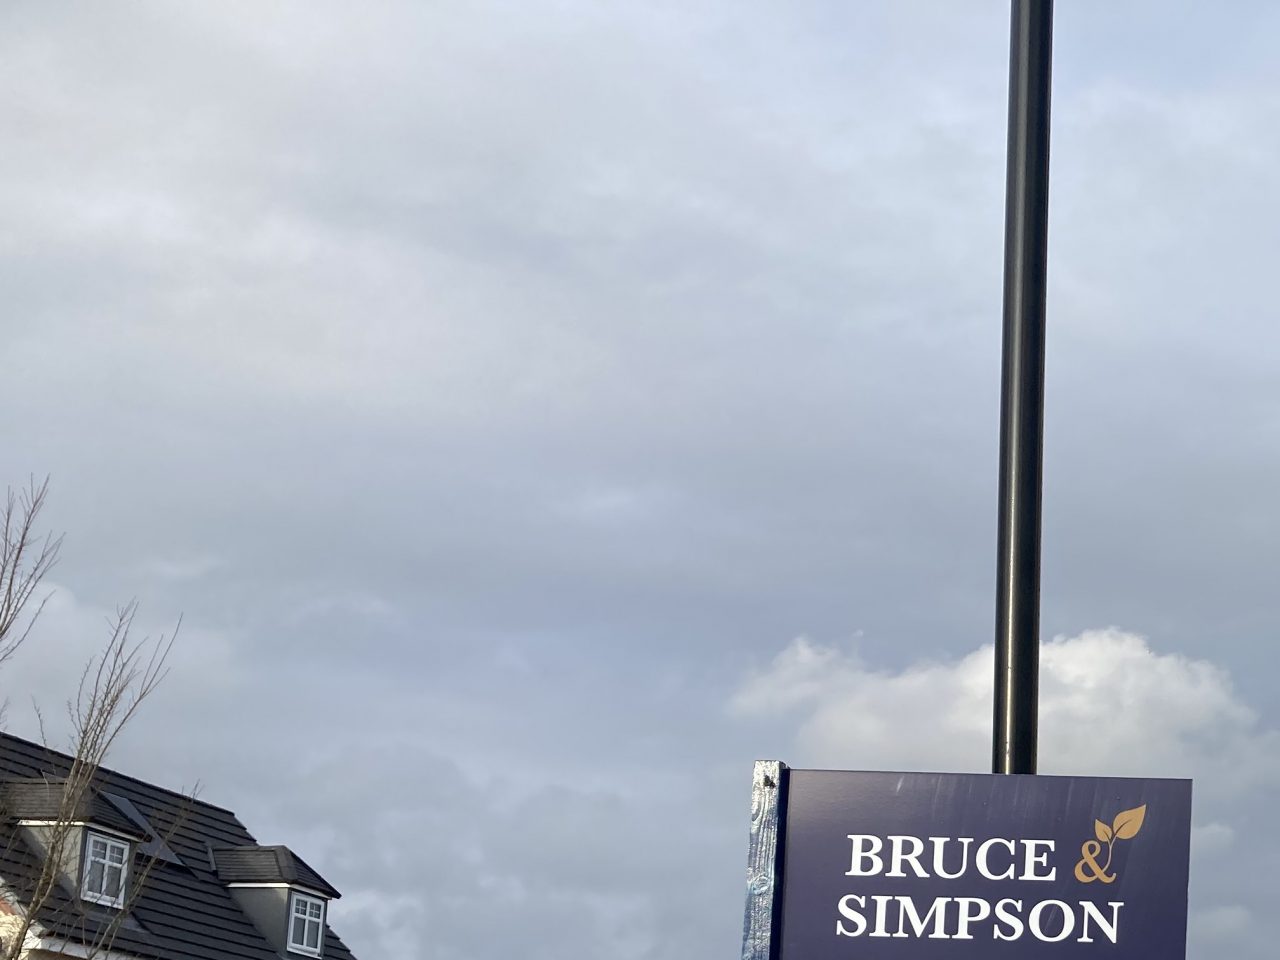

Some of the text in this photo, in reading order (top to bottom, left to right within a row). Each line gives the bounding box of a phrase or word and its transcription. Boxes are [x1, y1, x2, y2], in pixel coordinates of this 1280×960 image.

[845, 835, 1117, 884] BRUCE &
[836, 894, 1124, 943] SIMPSON
